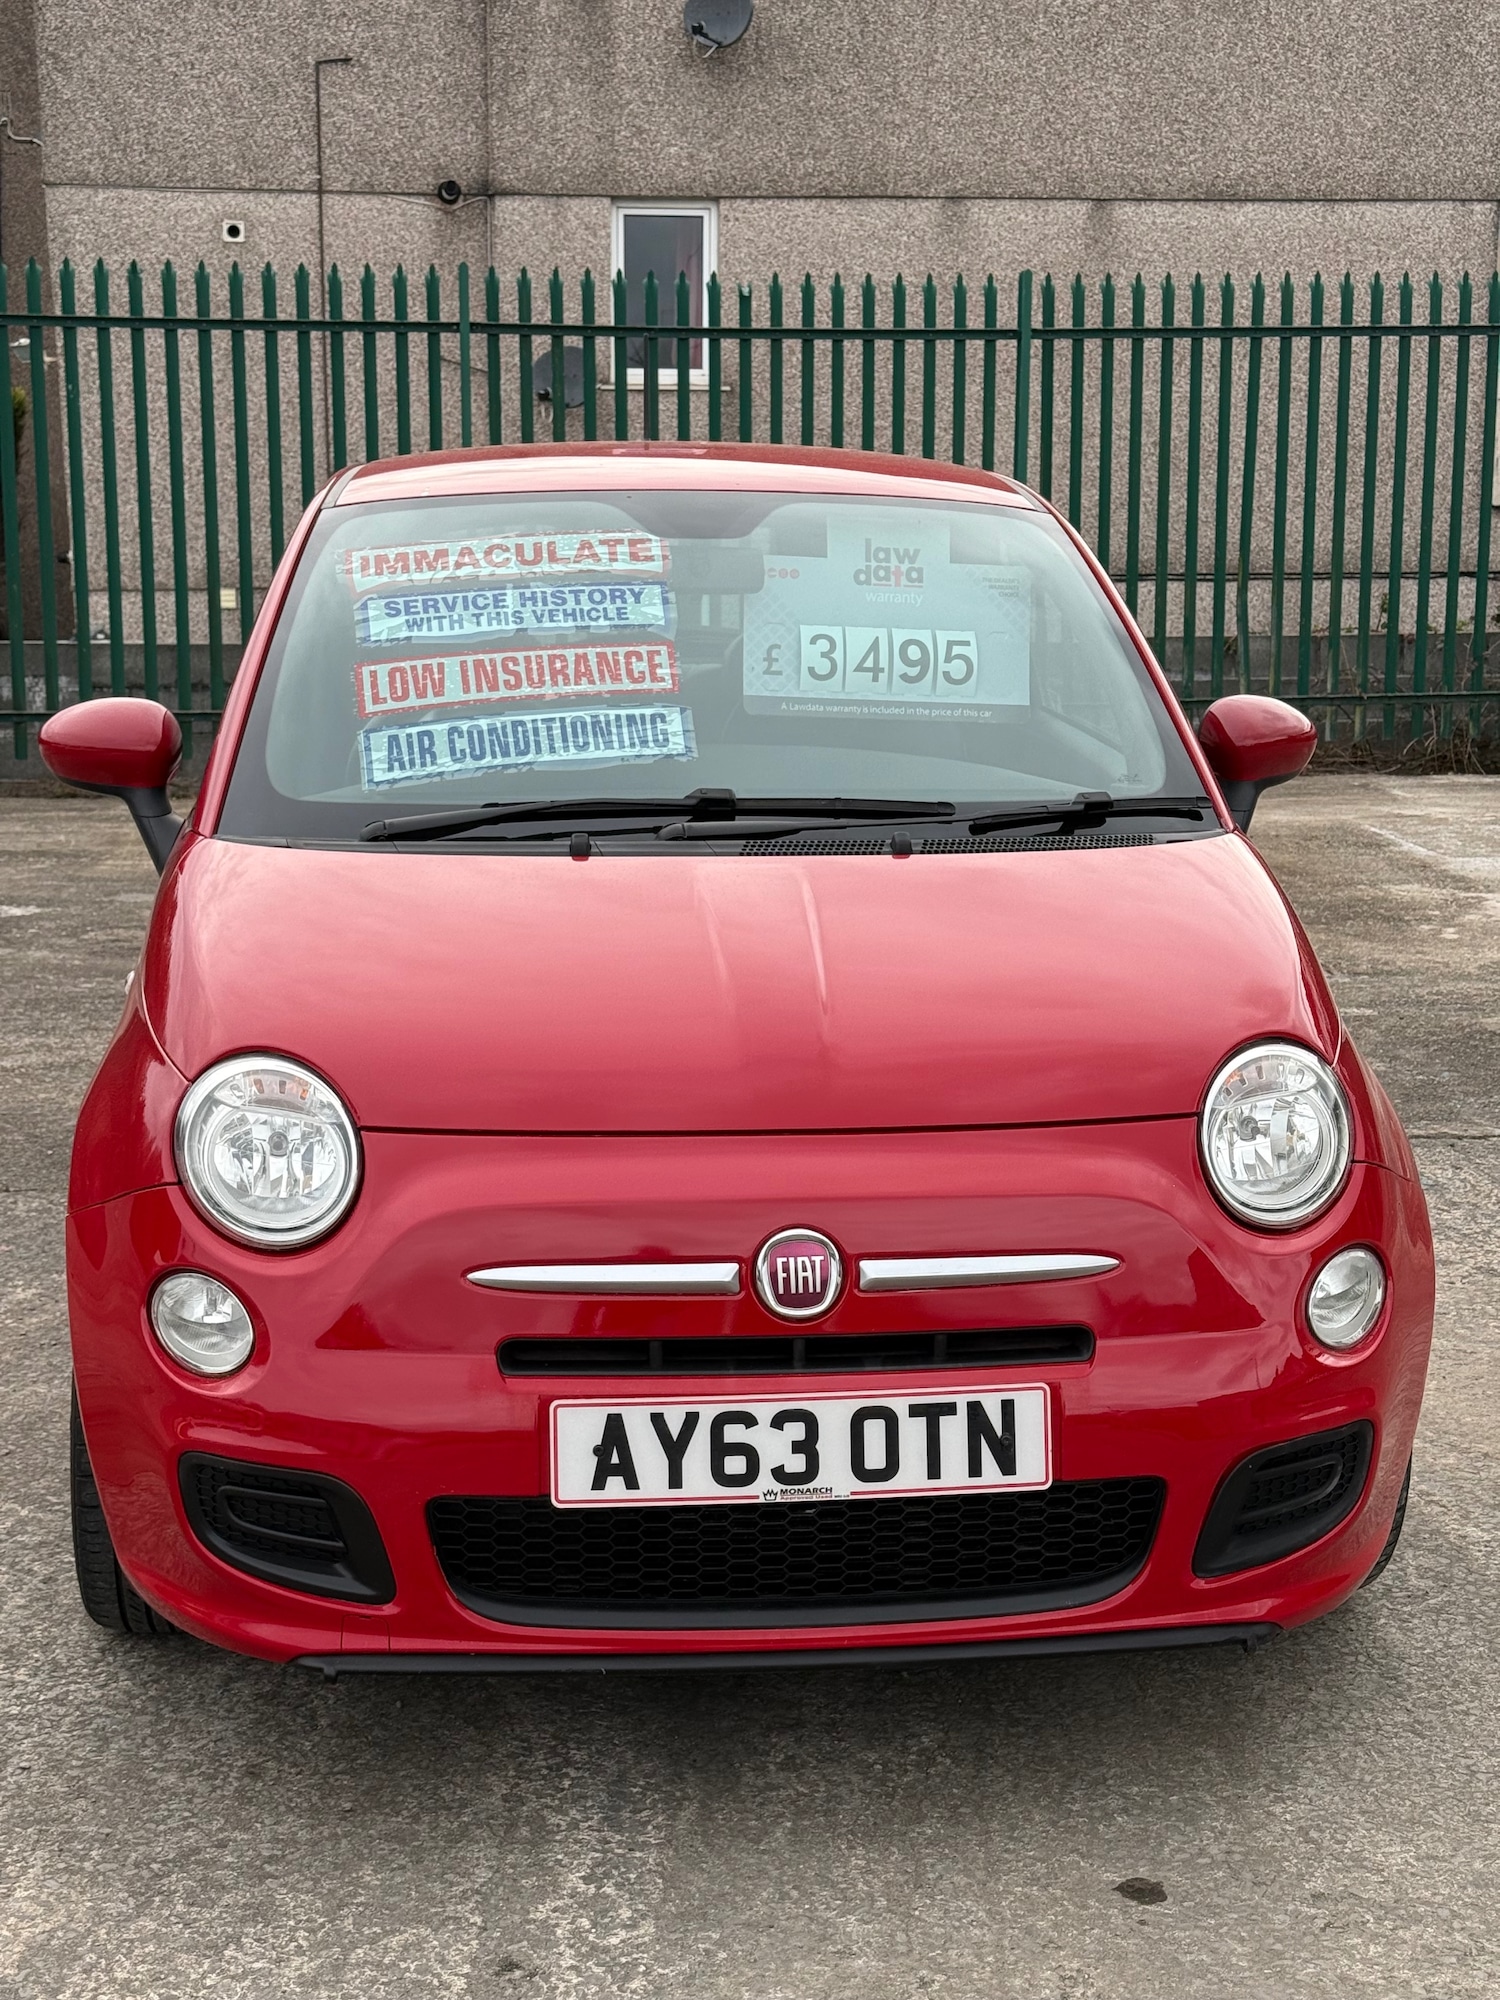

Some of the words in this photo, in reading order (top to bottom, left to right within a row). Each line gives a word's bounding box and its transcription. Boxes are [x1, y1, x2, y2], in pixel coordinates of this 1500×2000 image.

[360, 538, 656, 577] IMMACULATE
[864, 538, 921, 565] law
[853, 565, 924, 587] data
[384, 592, 510, 618] SERVICE
[519, 588, 646, 608] HISTORY
[866, 590, 923, 607] warranty
[405, 616, 464, 633] WITH
[475, 610, 525, 628] THIS
[532, 607, 630, 625] VEHICLE
[762, 643, 784, 676] £
[807, 633, 975, 686] 3495
[369, 662, 446, 706] LOW
[459, 650, 666, 695] INSURANCE
[781, 702, 788, 710] A
[789, 702, 824, 712] Lawdata
[825, 705, 861, 715] warranty
[862, 705, 869, 714] is
[869, 705, 905, 715] included
[906, 706, 914, 715] in
[916, 707, 930, 716] the
[931, 708, 951, 718] price
[953, 708, 962, 717] of
[963, 708, 978, 717] this
[979, 710, 992, 718] car
[387, 730, 438, 773] AIR
[447, 712, 671, 764] CONDITIONING
[776, 1255, 825, 1294] FIAT
[591, 1408, 820, 1491] AY63
[849, 1398, 1017, 1483] OTN
[780, 1487, 833, 1495] MONARCH
